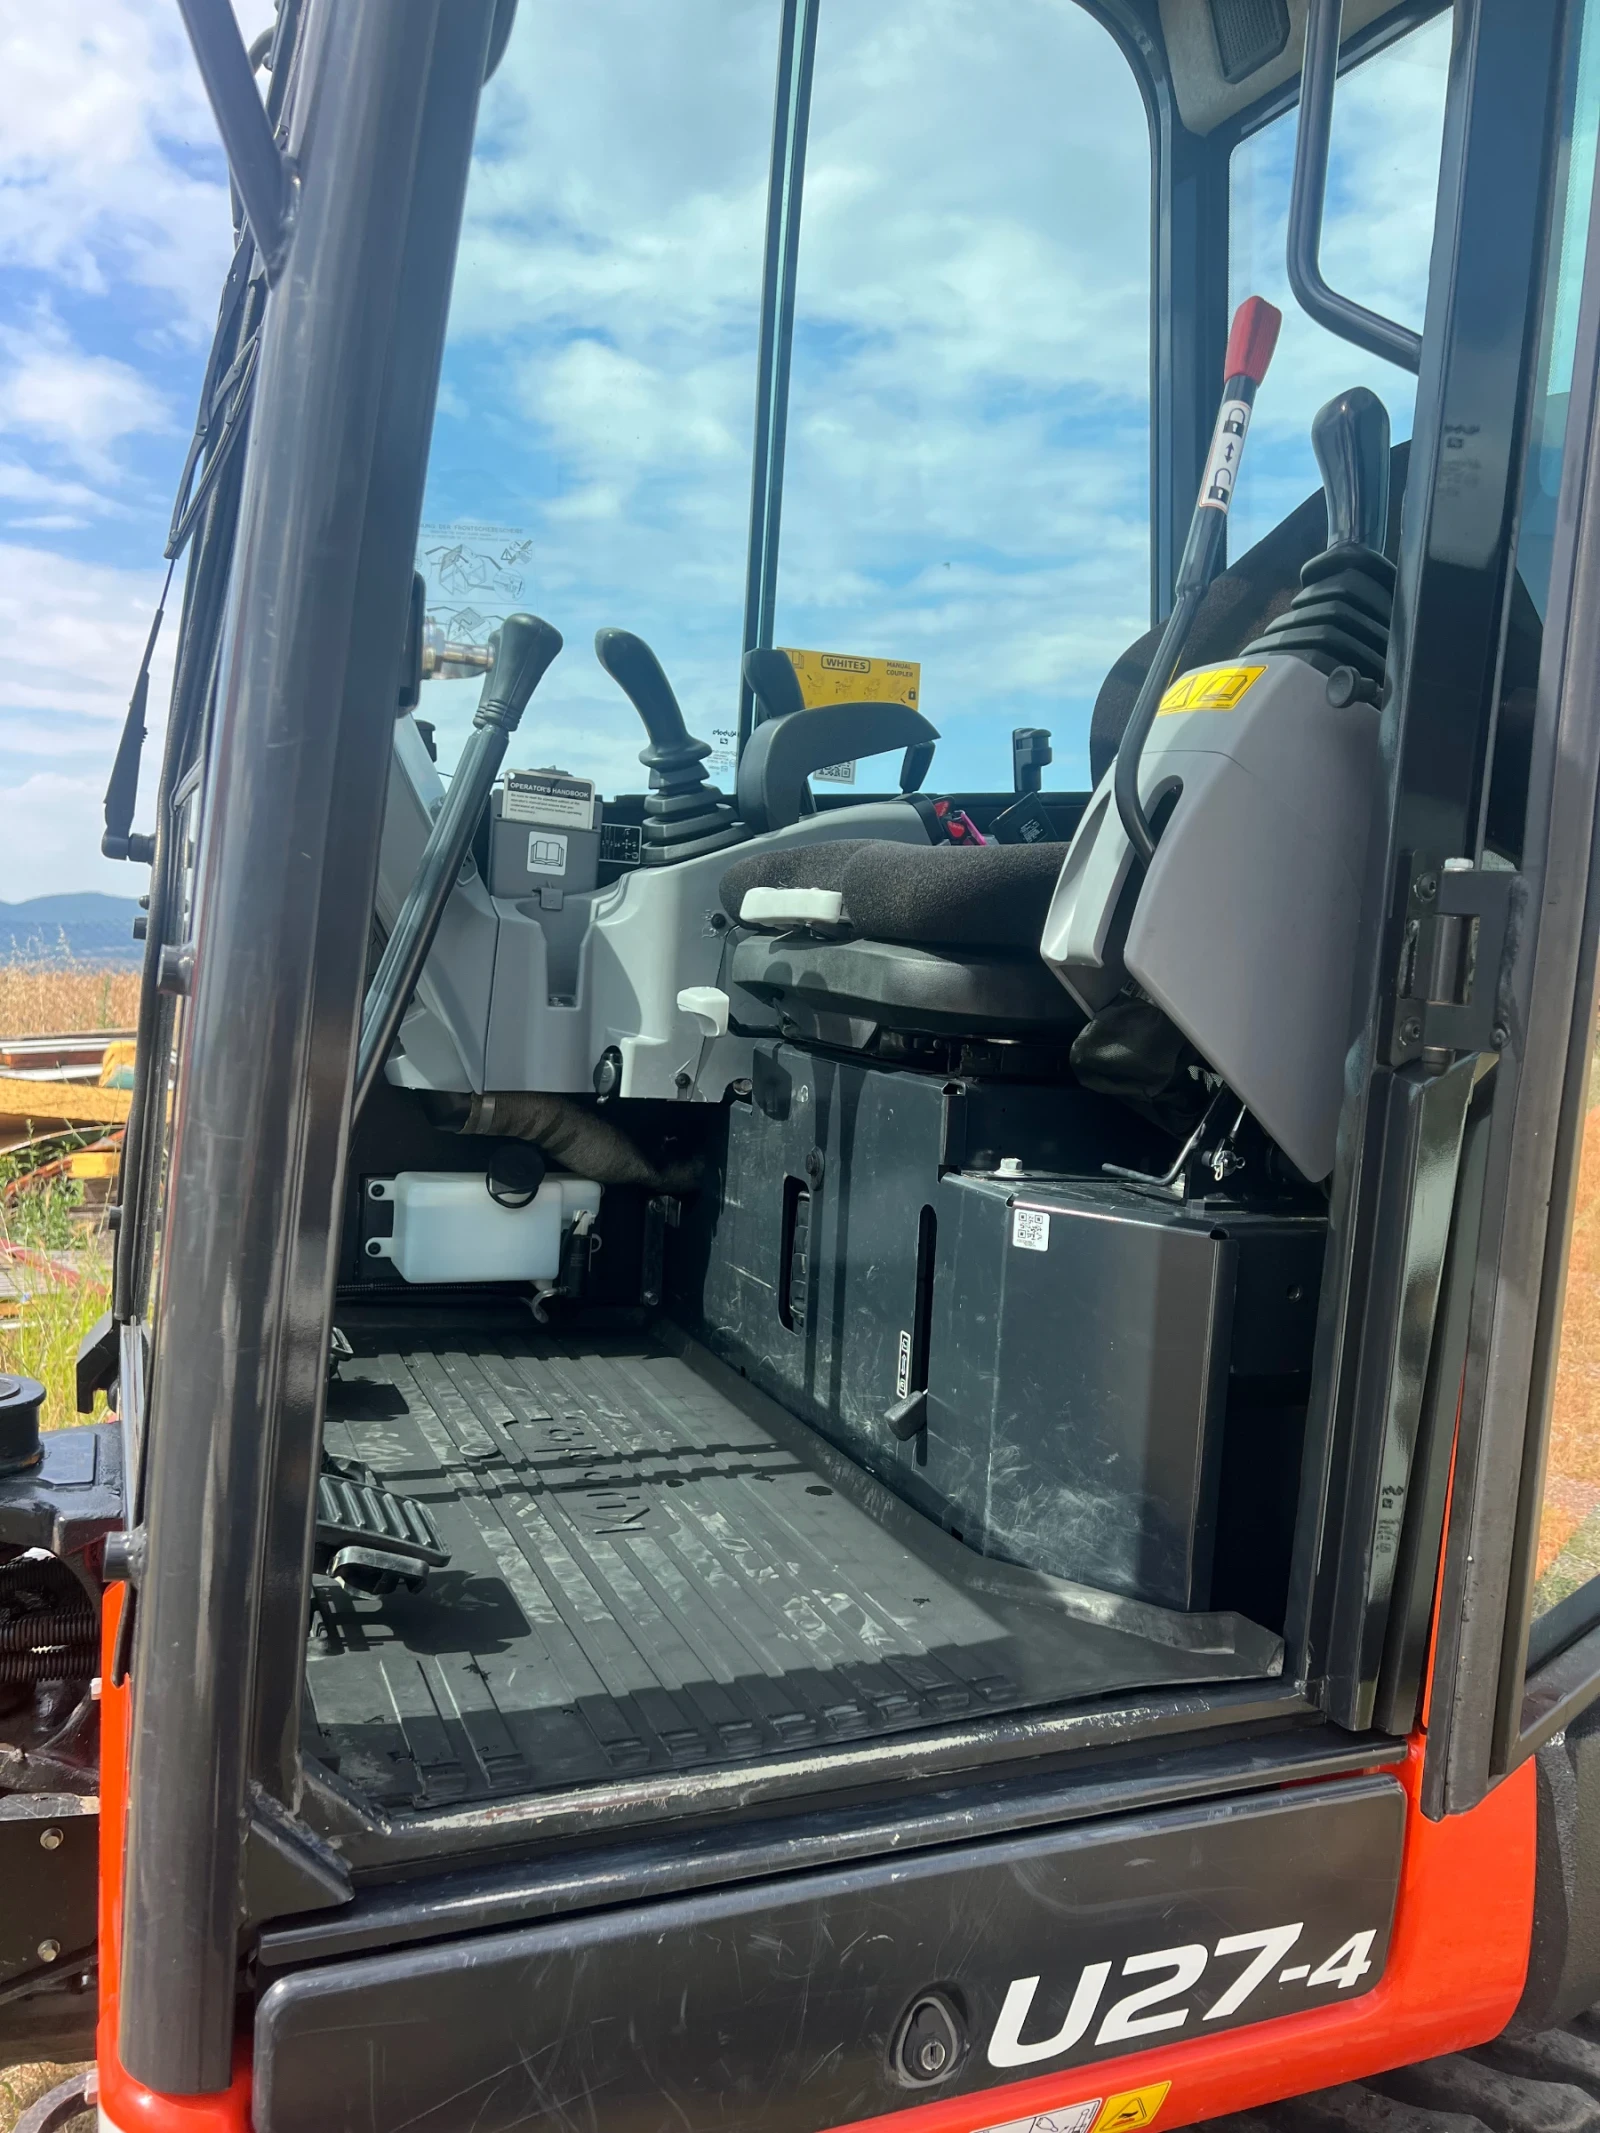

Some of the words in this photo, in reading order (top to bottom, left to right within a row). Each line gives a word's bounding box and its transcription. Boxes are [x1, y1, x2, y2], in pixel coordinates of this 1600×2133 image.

[826, 658, 866, 671] WHITES
[886, 661, 912, 670] MANUAL
[886, 669, 914, 678] COUPLER
[510, 782, 552, 794] OPERATOR'S
[552, 788, 589, 798] HANDBOOK
[986, 1921, 1377, 2069] U27-4
